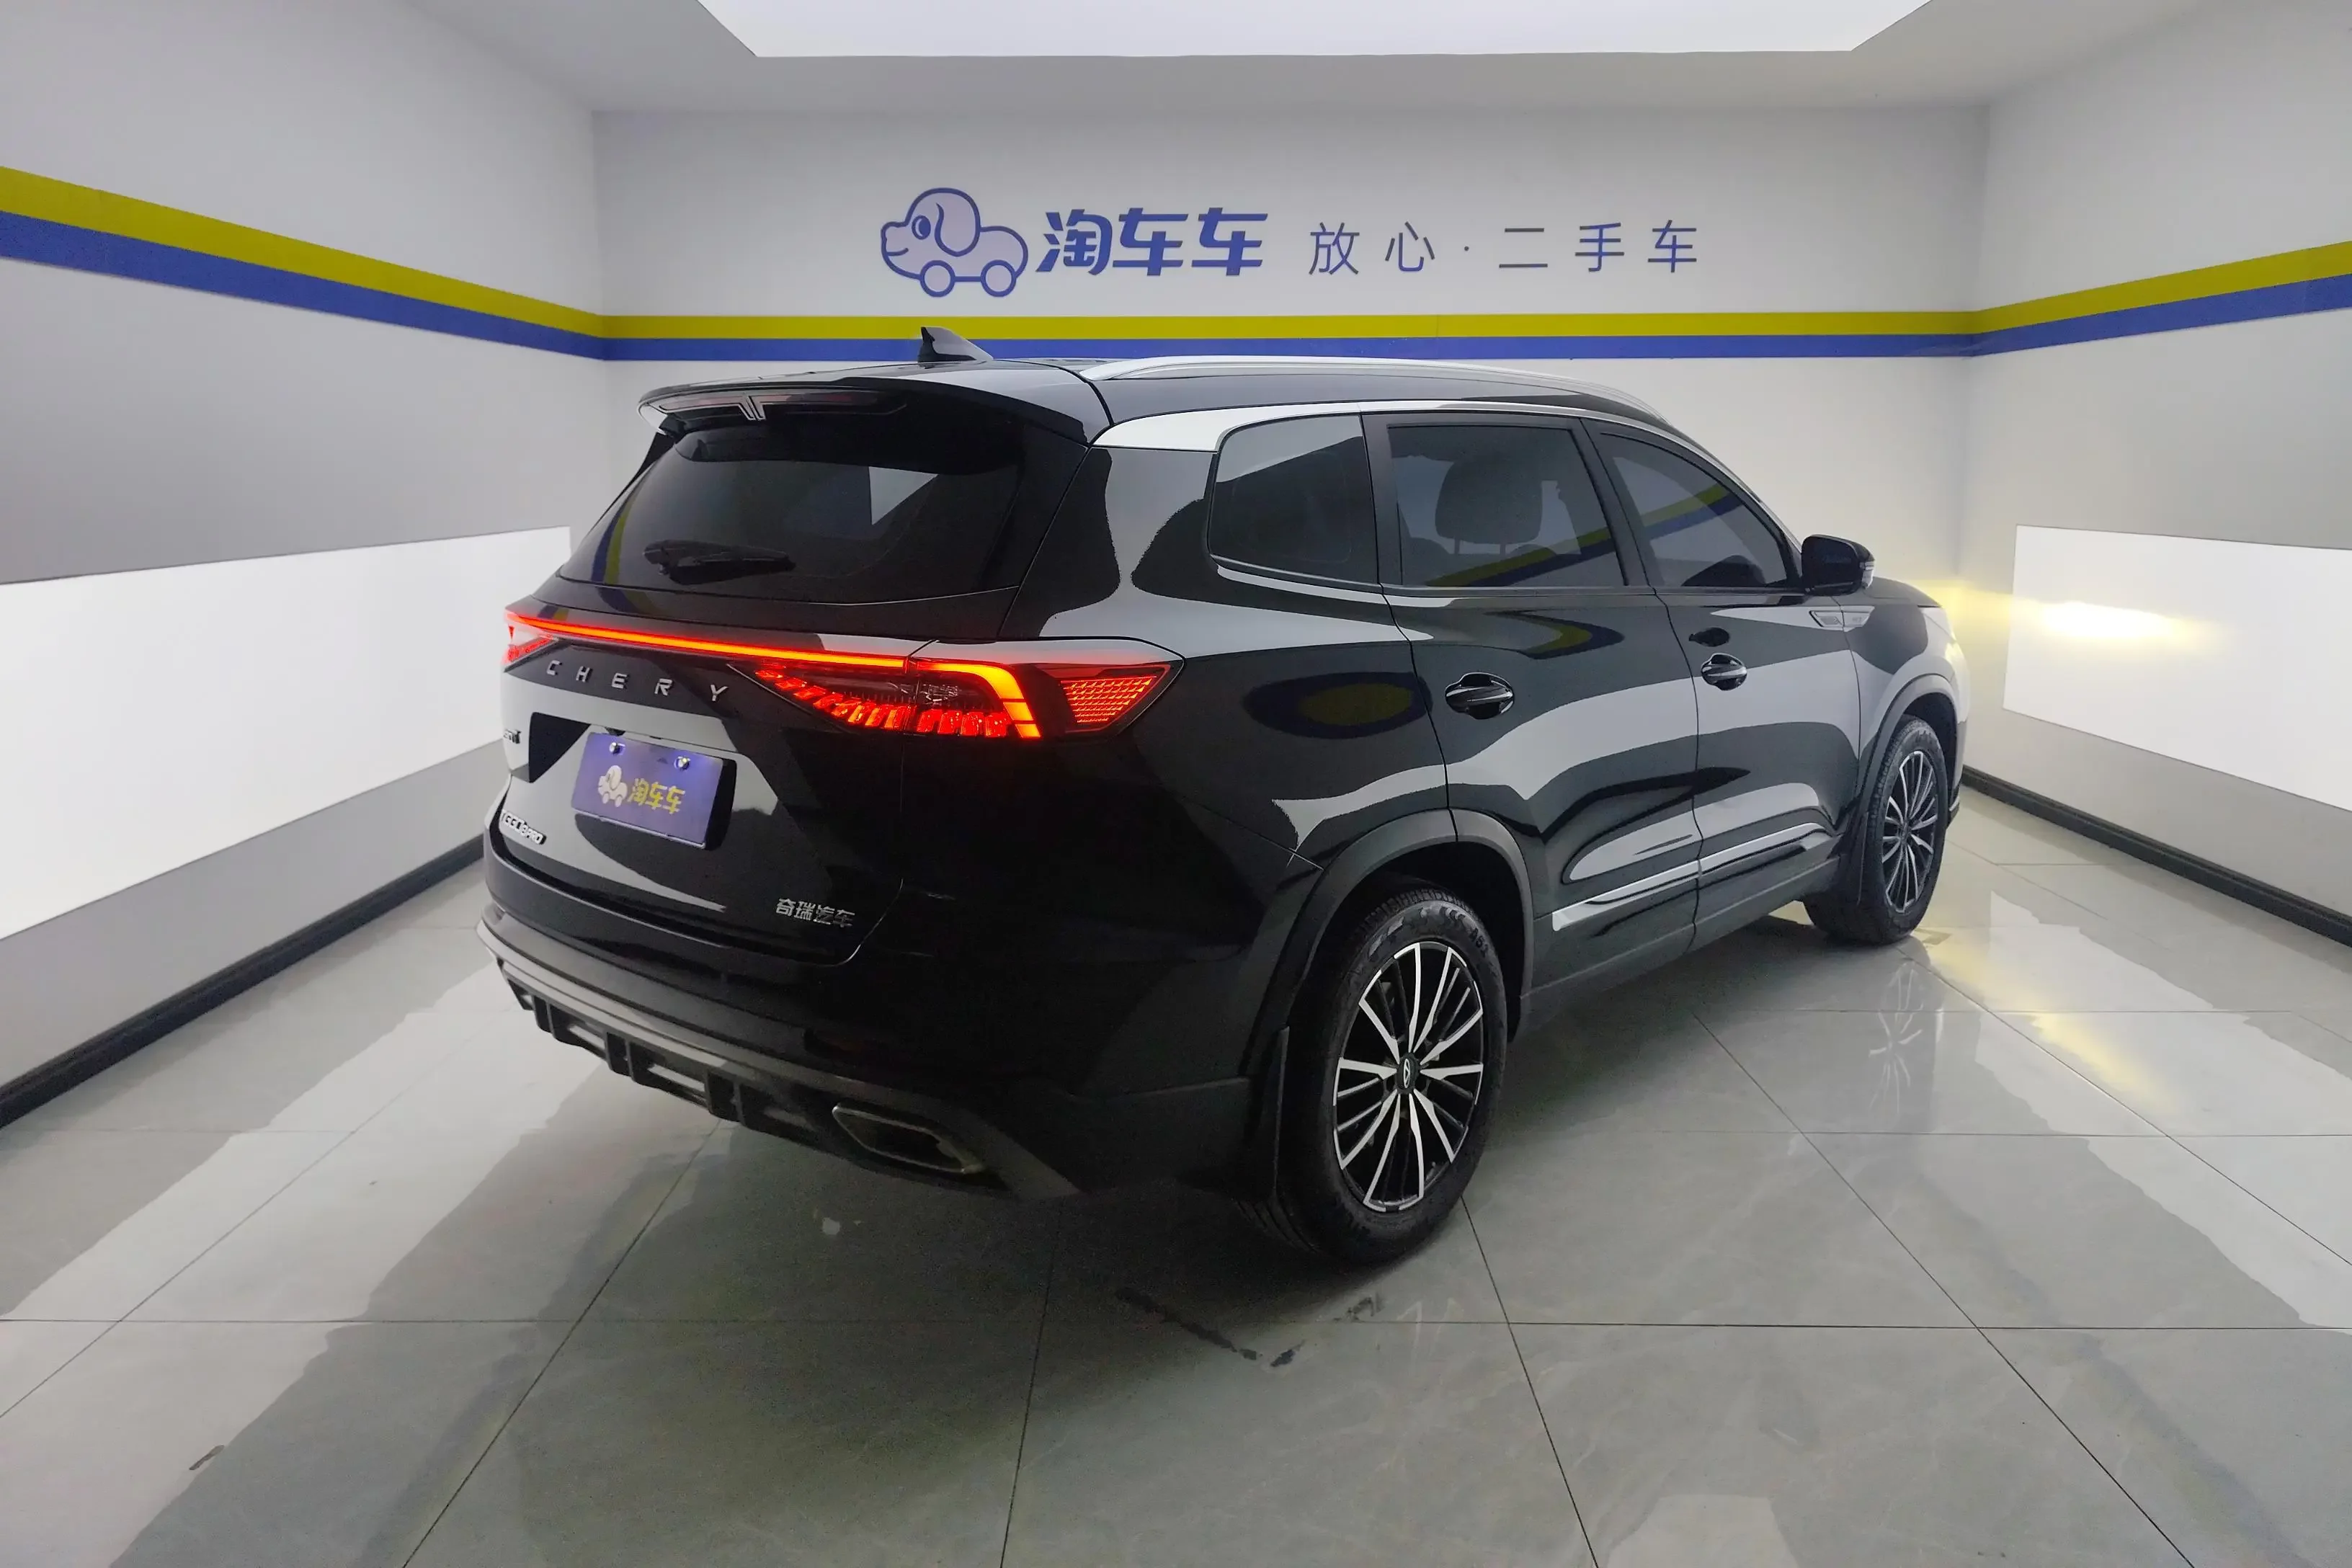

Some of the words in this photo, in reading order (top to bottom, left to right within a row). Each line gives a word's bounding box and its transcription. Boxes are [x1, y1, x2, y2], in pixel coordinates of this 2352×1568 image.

[1035, 207, 1268, 277] 淘车车
[546, 659, 729, 702] CHERY
[627, 778, 686, 814] 淘车车
[775, 898, 856, 928] 奇瑞汽车
